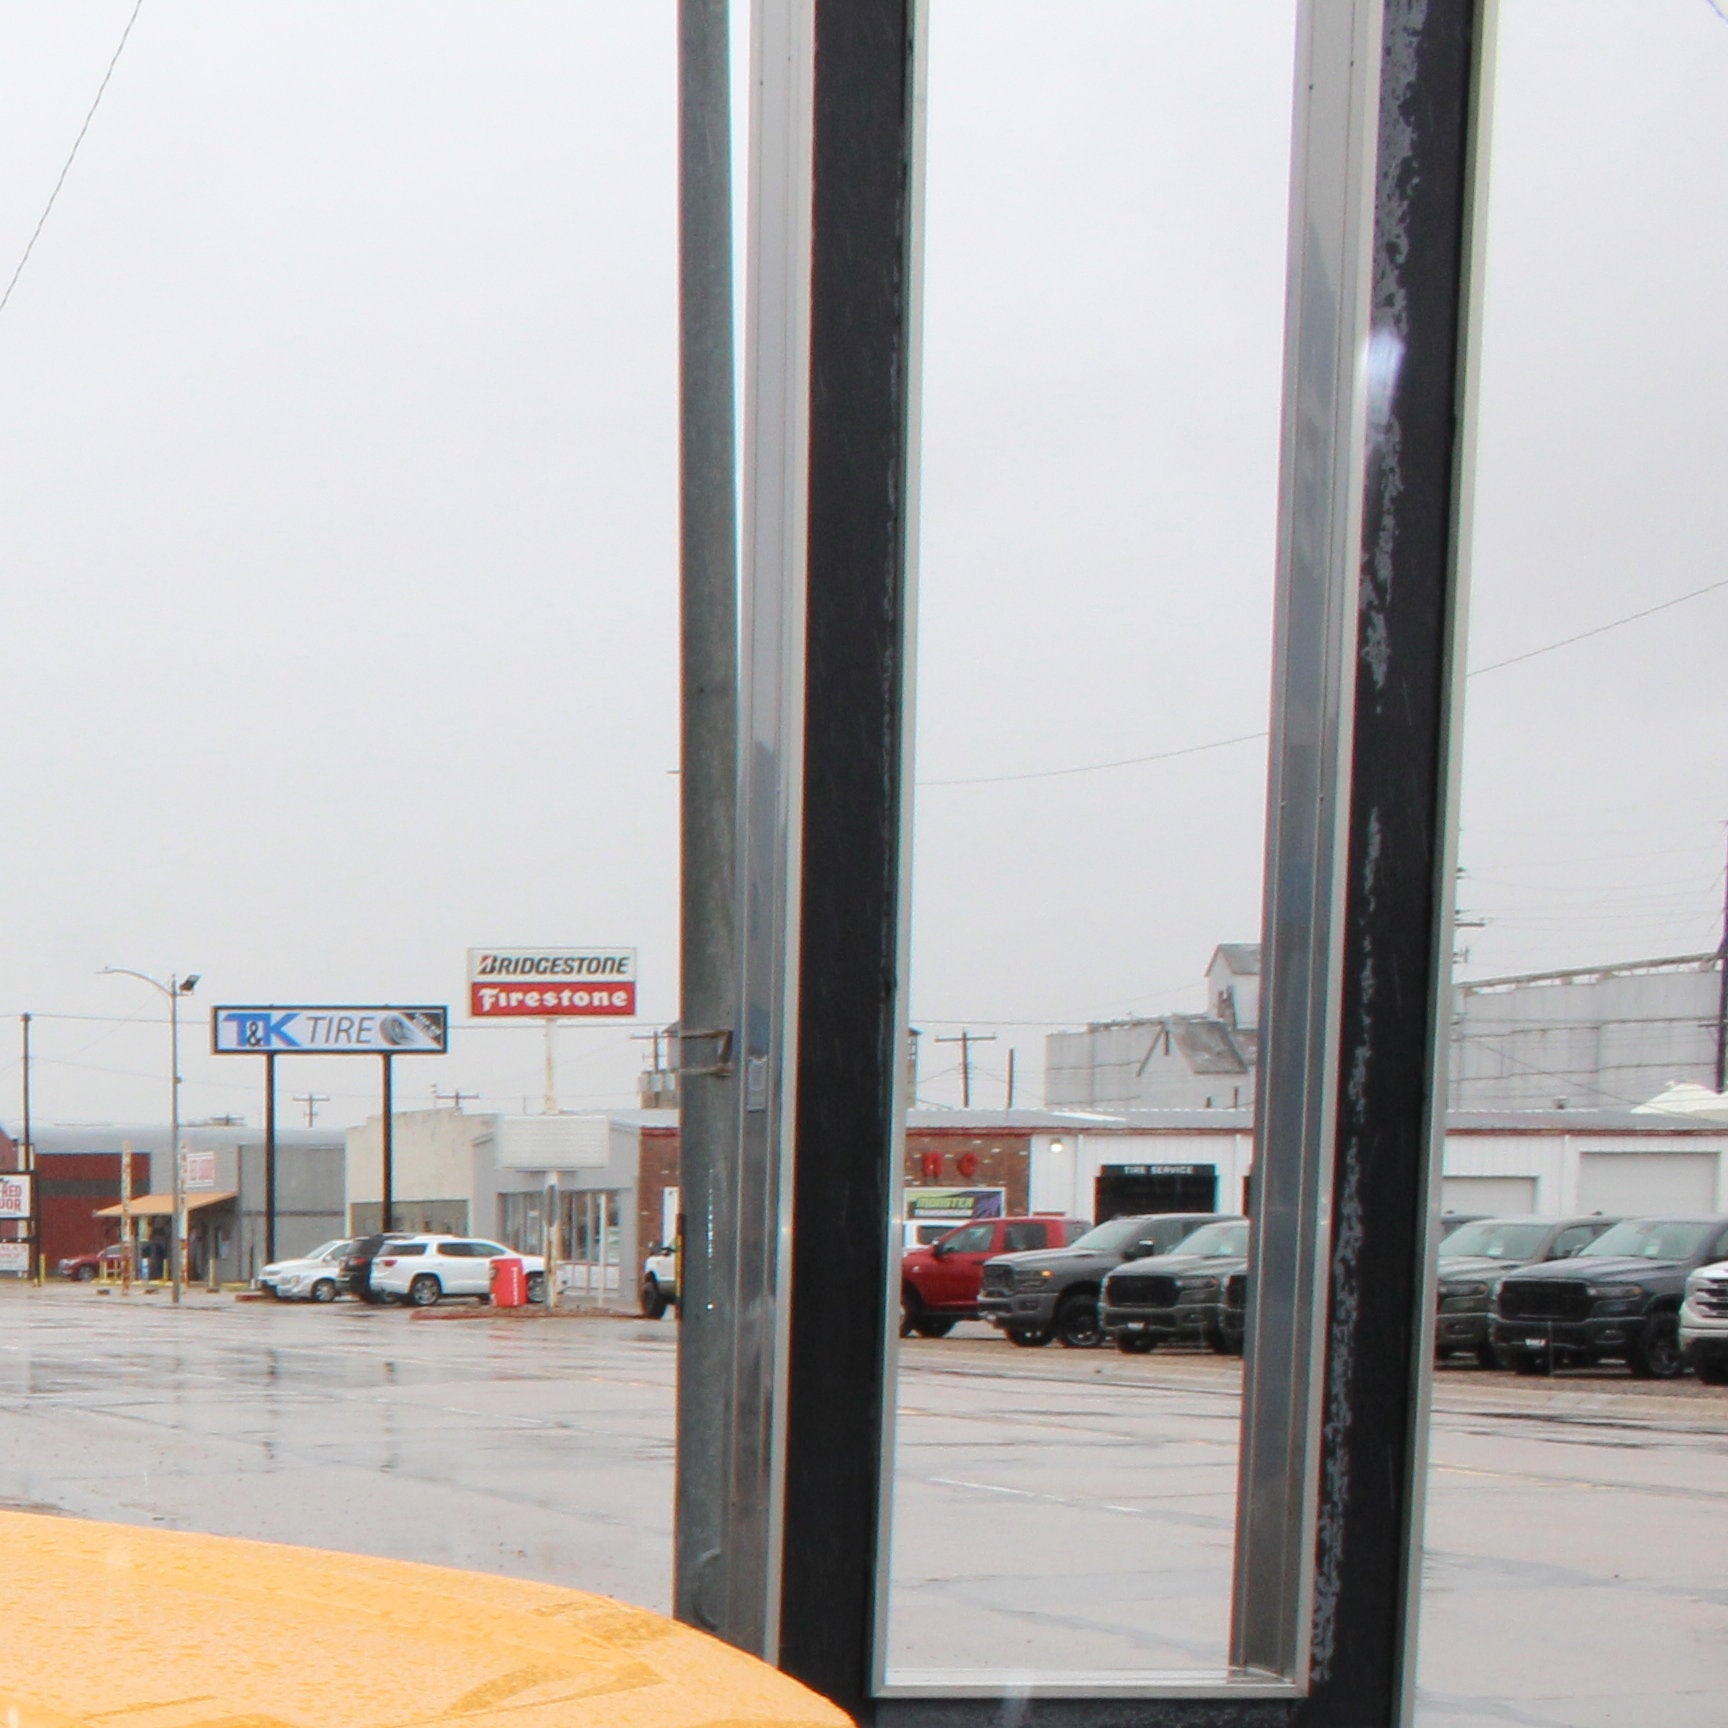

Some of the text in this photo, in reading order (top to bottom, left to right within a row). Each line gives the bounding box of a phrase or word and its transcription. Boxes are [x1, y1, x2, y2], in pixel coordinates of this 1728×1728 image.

[478, 955, 630, 975] BRIDGESTONE
[478, 987, 629, 1012] Firestone
[223, 1012, 301, 1048] T&K
[305, 1016, 375, 1045] TIRE
[3, 1184, 22, 1197] RED
